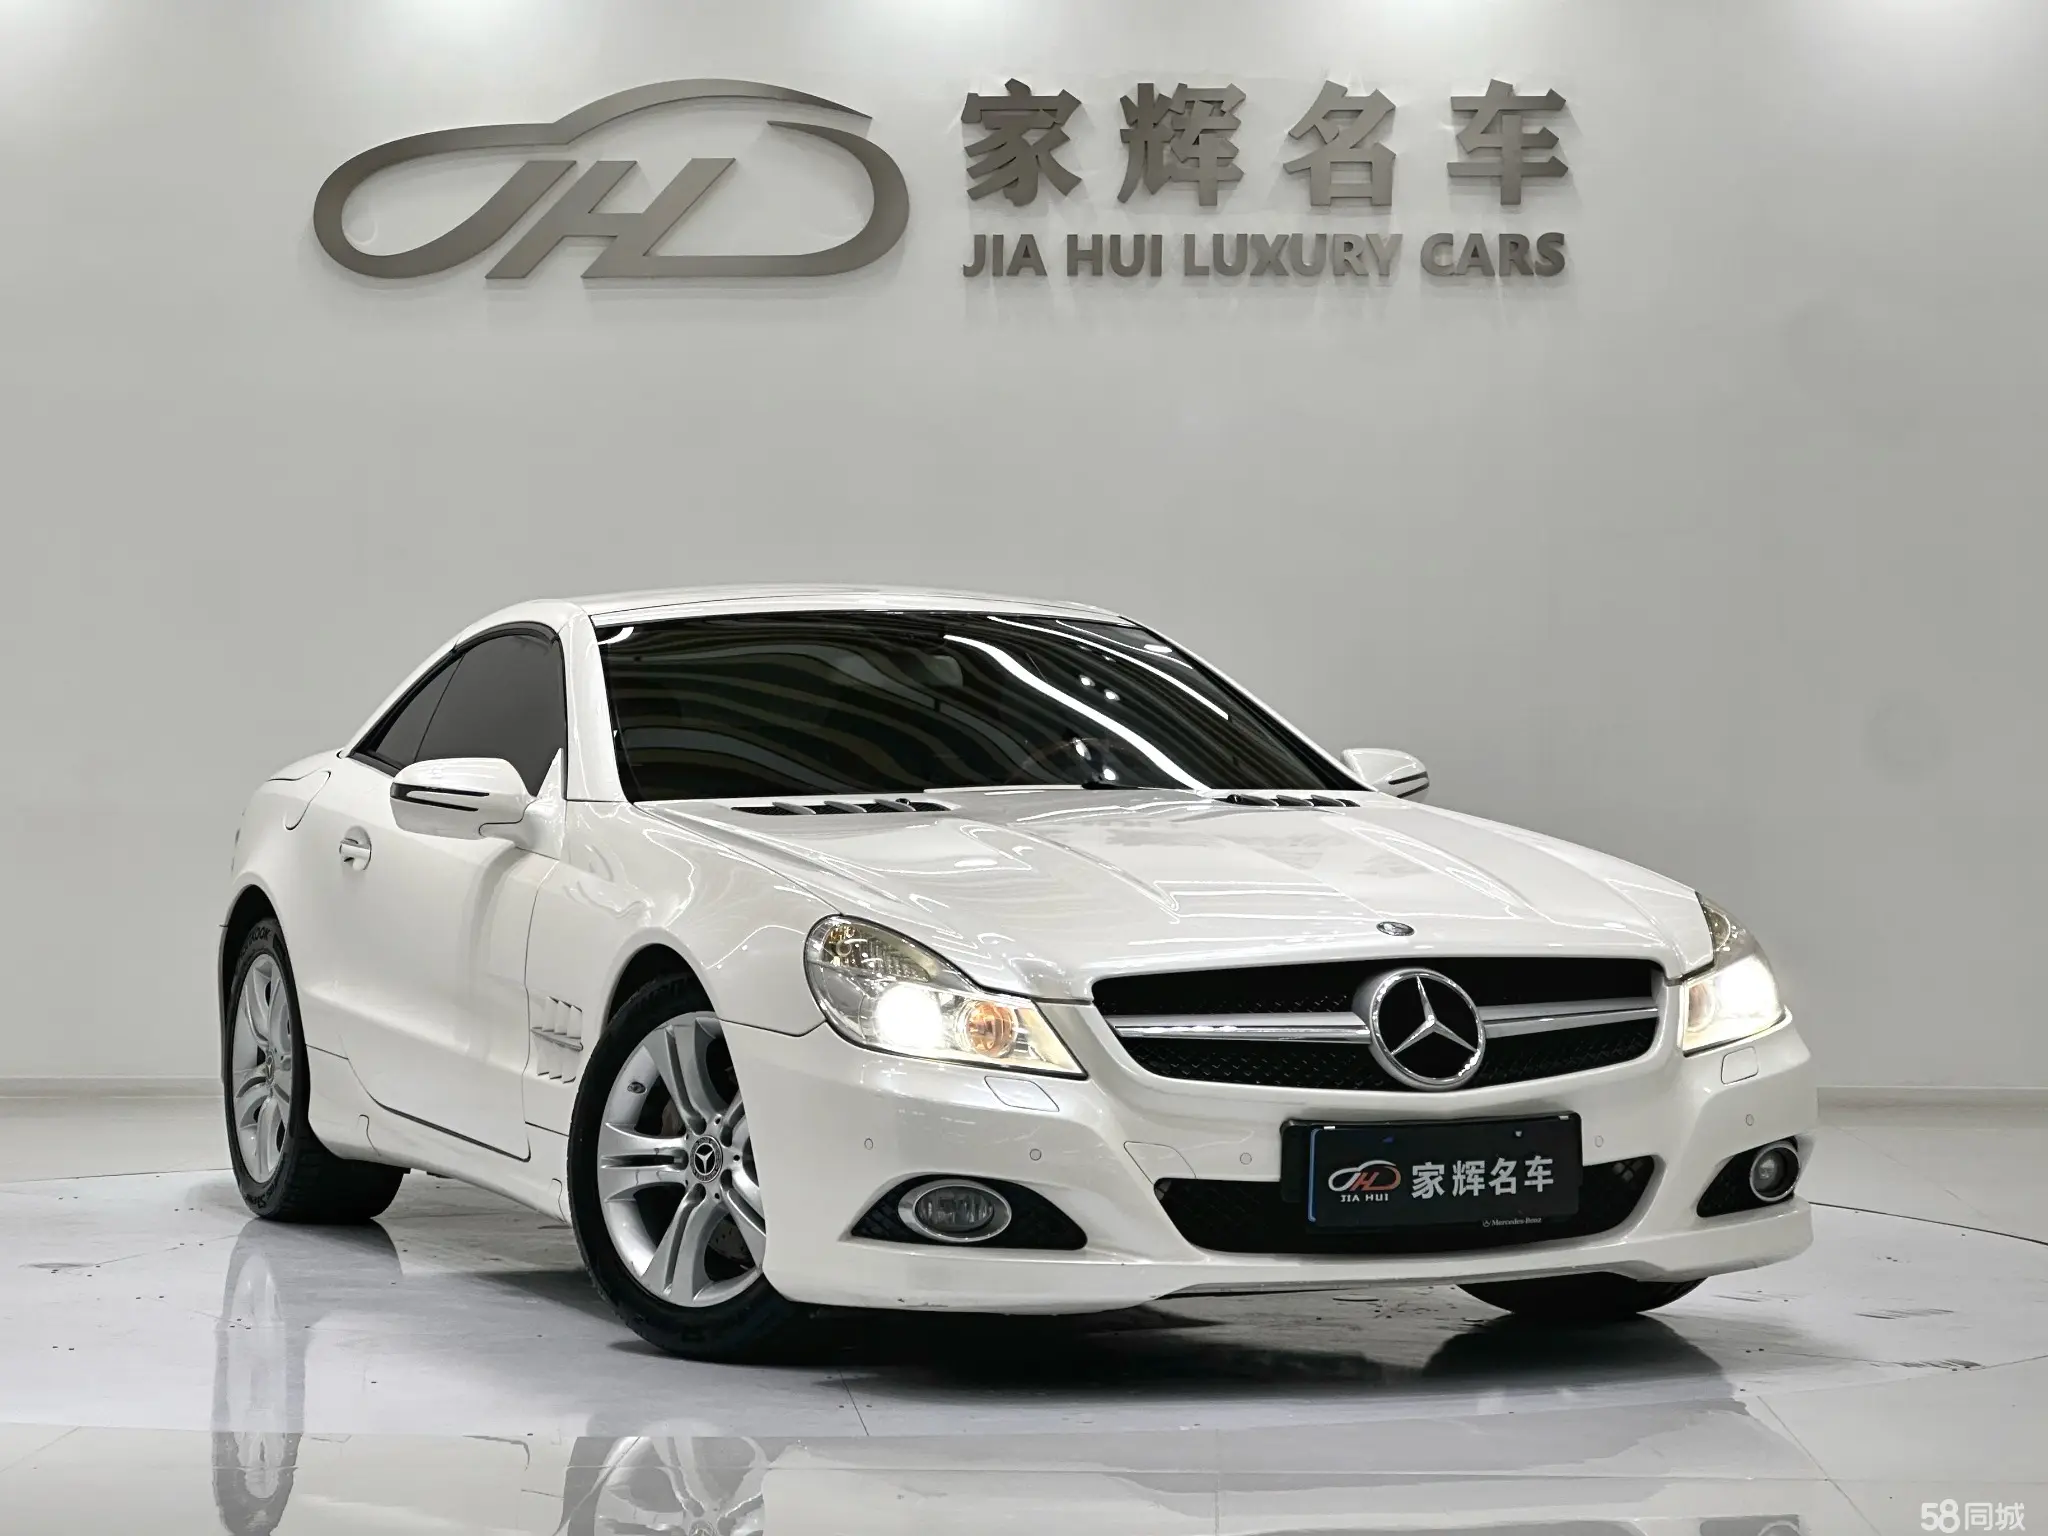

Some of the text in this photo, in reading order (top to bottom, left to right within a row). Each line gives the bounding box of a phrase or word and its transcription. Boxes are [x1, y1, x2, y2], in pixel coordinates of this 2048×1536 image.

[961, 78, 1569, 206] 家辉名车
[962, 232, 1567, 277] JIA HUI LUXURY CARS
[1340, 1193, 1389, 1203] JIA HUI
[1411, 1155, 1554, 1200] 家辉名车
[1491, 1216, 1543, 1227] Mercedes-Benz
